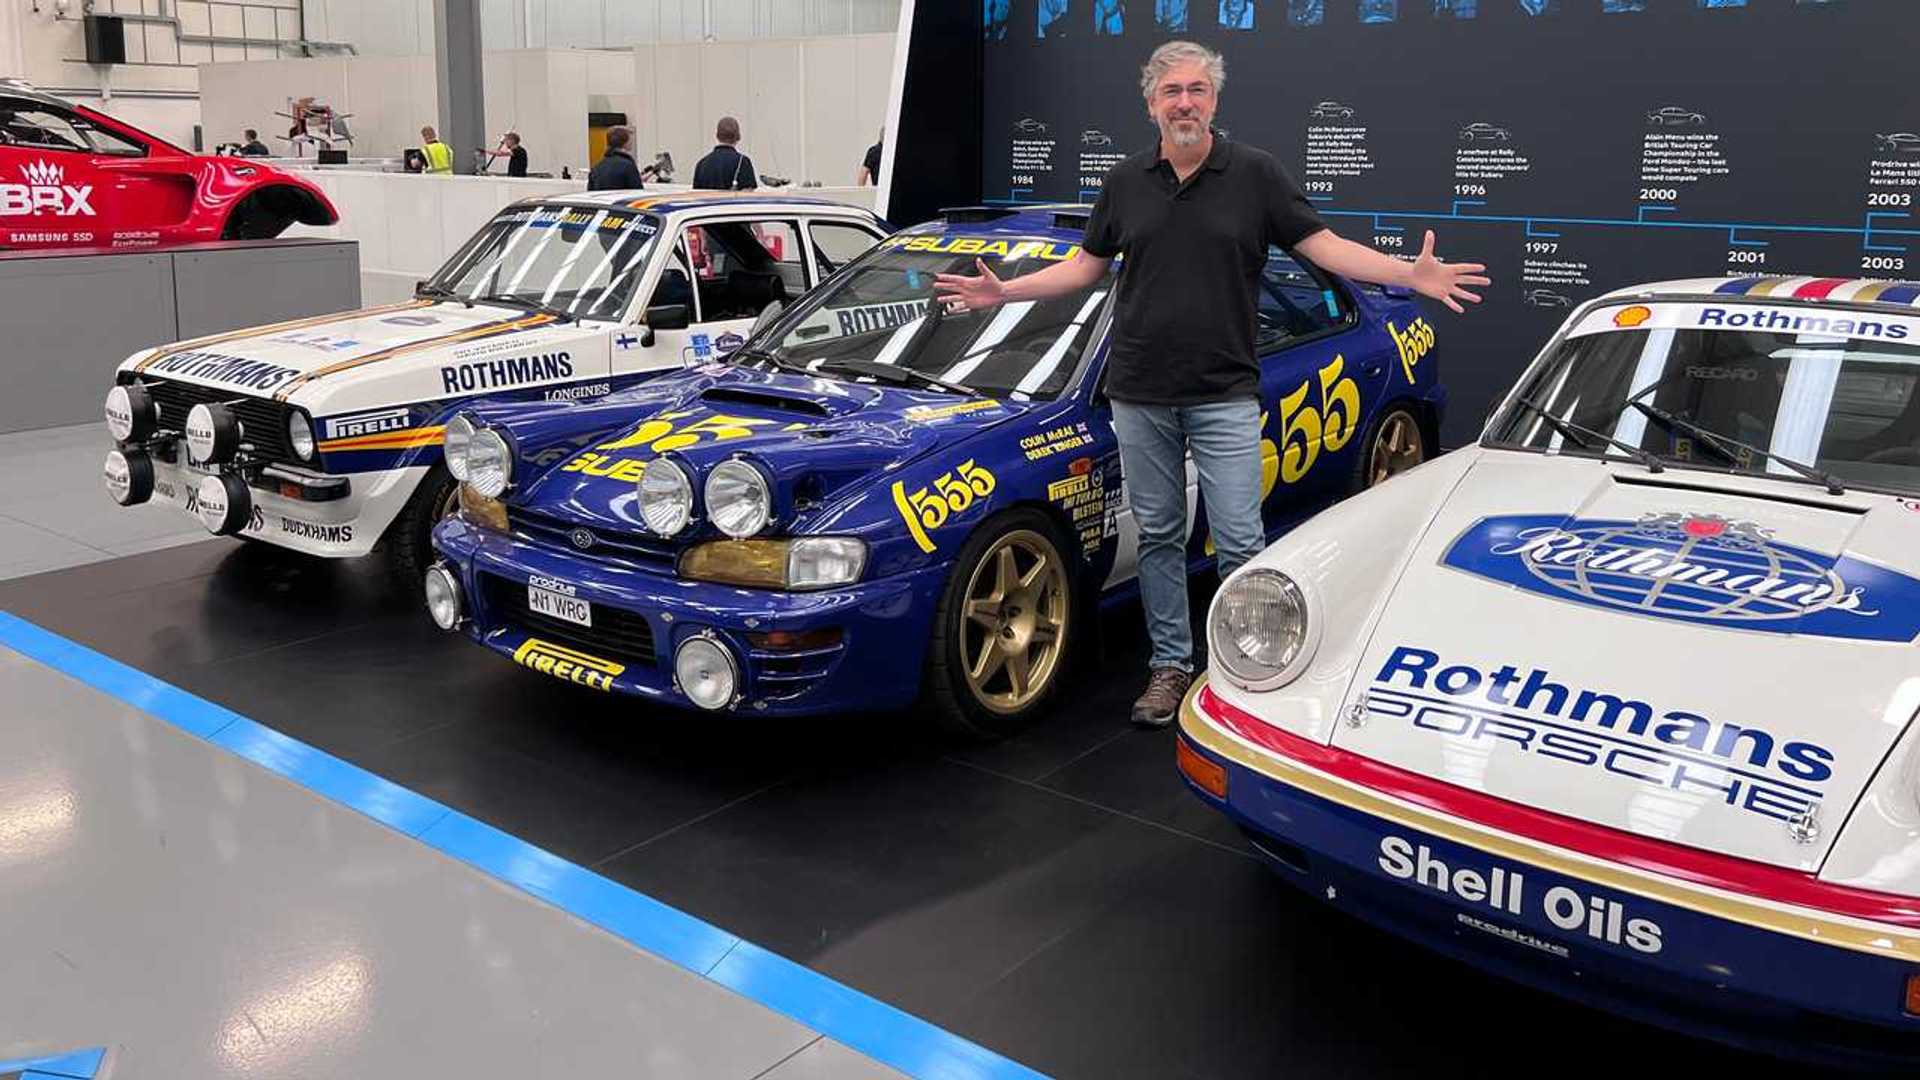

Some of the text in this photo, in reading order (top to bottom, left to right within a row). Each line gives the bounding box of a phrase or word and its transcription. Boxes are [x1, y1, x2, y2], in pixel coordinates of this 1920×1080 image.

[1012, 175, 1034, 184] 1984
[1080, 177, 1104, 186] 1986
[1305, 181, 1333, 191] 1993
[1454, 184, 1486, 195] 1996
[0, 183, 96, 216] BRX
[1640, 189, 1677, 200] 2000
[1867, 193, 1911, 206] 2003
[11, 231, 94, 242] SAMSUNG SSD
[1373, 236, 1403, 247] 1995
[1525, 242, 1558, 253] 1997
[903, 237, 1081, 261] SUBARU
[1728, 251, 1766, 263] 2001
[1861, 257, 1905, 270] 2003
[1698, 307, 1910, 339] Rothmans
[1399, 317, 1435, 367] 555
[154, 352, 302, 390] ROTHMANS
[441, 353, 573, 394] ROTHMANS
[1684, 367, 1760, 381] RECARO
[544, 383, 610, 401] LONGINES
[326, 408, 410, 438] PIRELLI
[1020, 433, 1047, 449] COLIN
[908, 458, 996, 529] 555
[1048, 474, 1088, 501] PIRELLI
[282, 516, 353, 542] DUCKHAMS
[1490, 526, 1880, 616] Rothmans
[513, 638, 626, 692] PIRELLI
[1375, 645, 1836, 783] Rothmans
[1365, 696, 1820, 824] PORSCHE
[1378, 835, 1663, 954] Shell Oils
